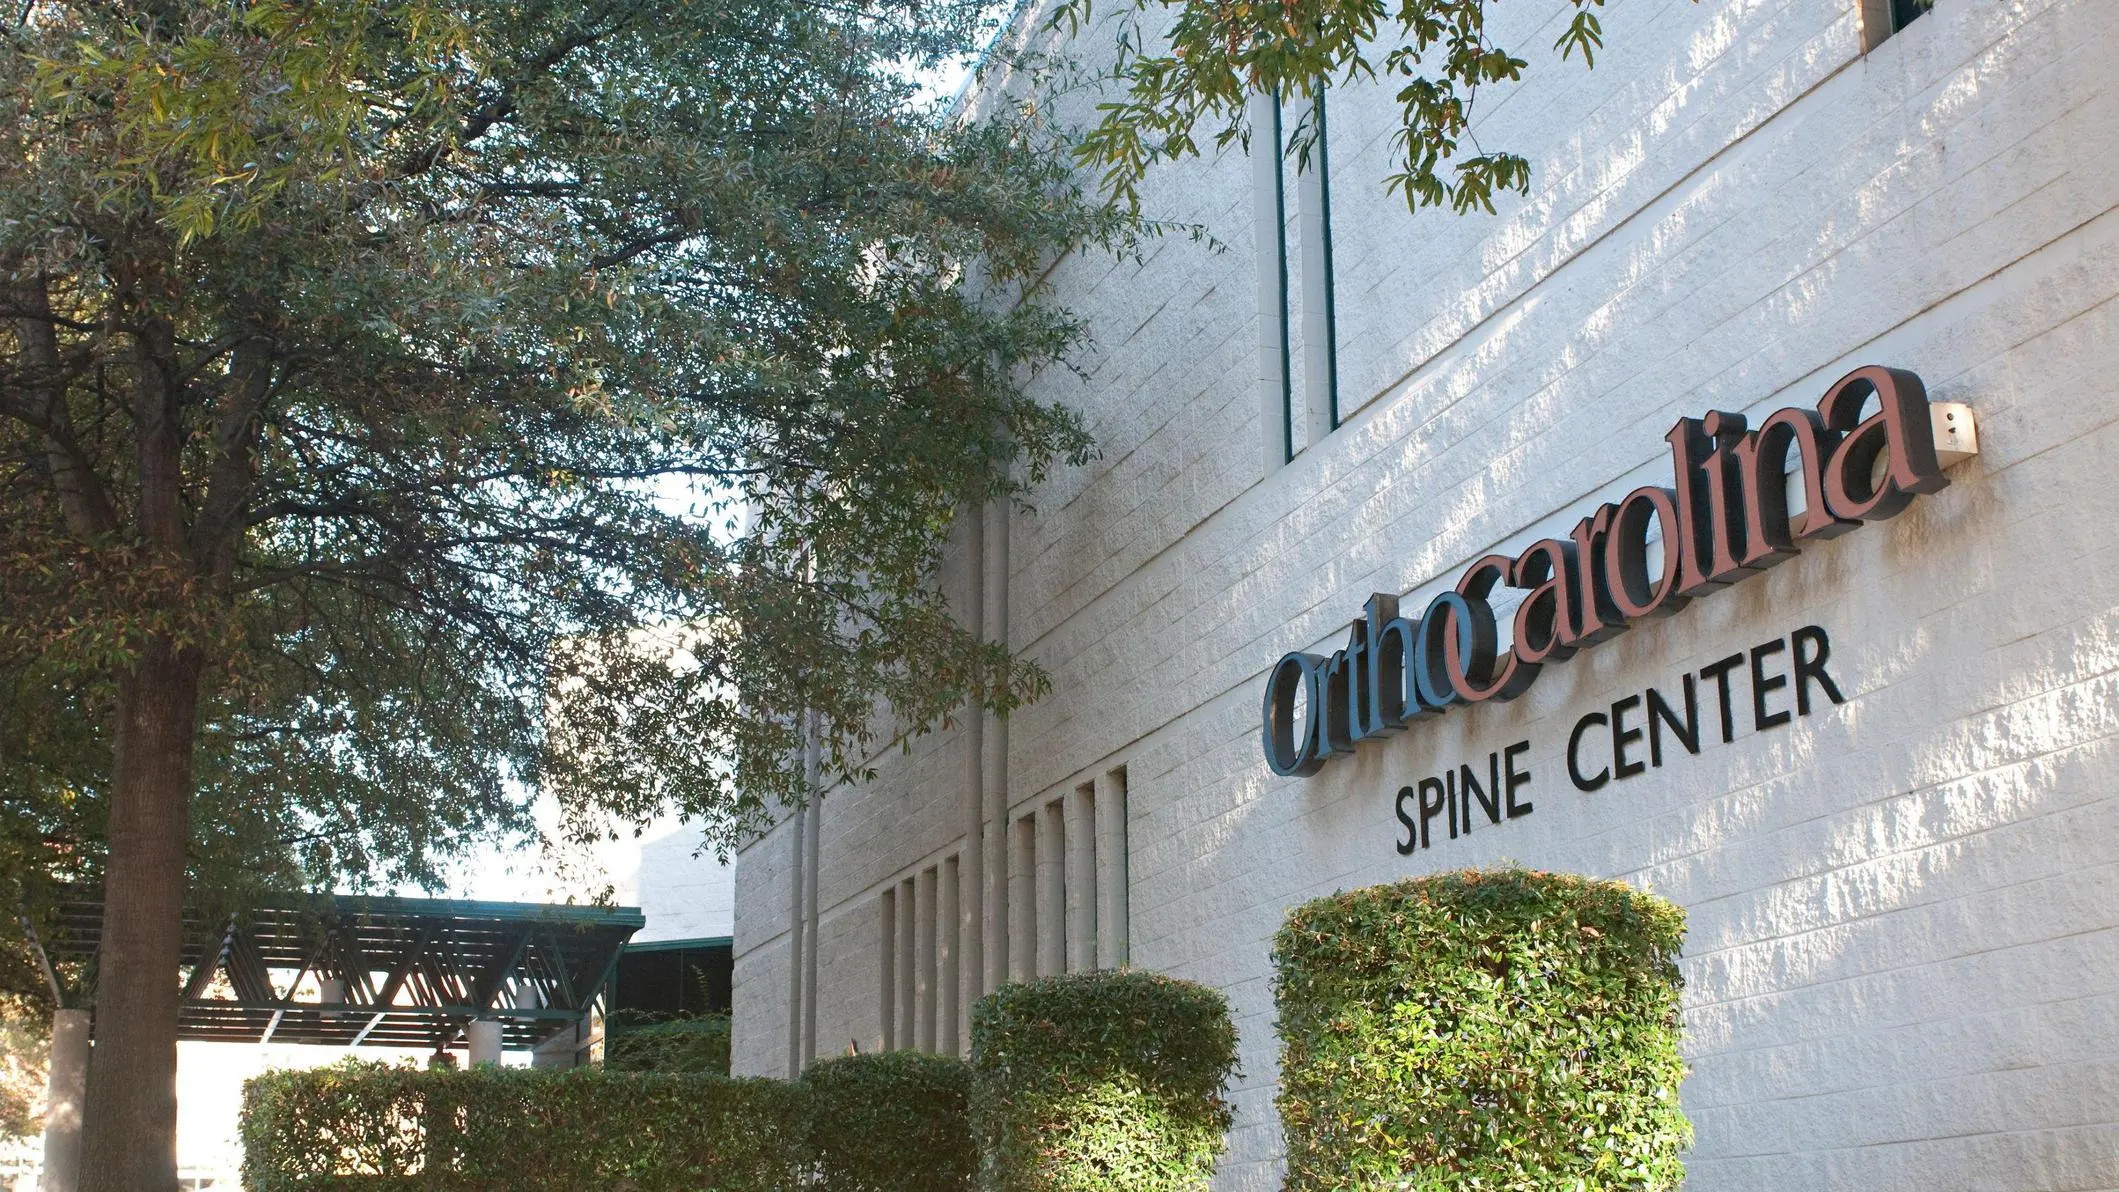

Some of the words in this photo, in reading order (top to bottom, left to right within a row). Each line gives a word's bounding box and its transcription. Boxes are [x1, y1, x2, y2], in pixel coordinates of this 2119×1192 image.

[1263, 365, 1949, 777] OrthoCarolina
[1395, 740, 1533, 856] SPINE
[1567, 625, 1844, 792] CENTER
